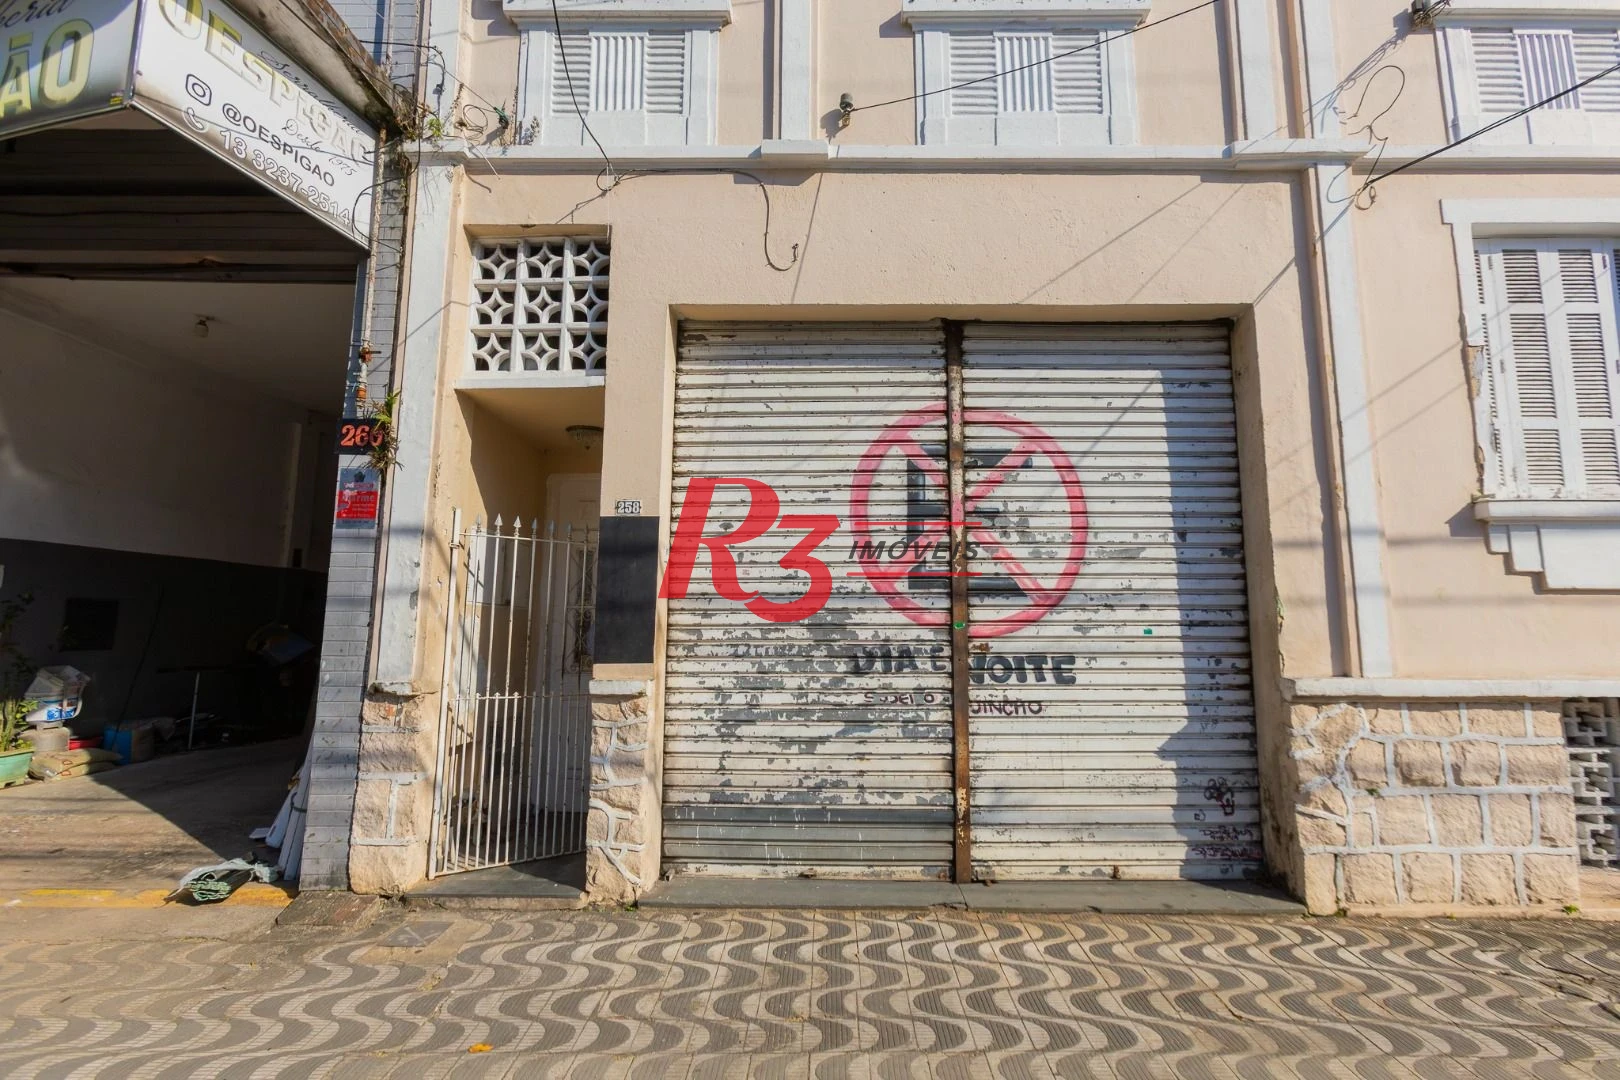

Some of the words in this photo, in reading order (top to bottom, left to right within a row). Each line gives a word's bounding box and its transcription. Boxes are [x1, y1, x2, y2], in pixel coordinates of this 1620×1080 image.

[220, 129, 248, 159] 13
[252, 150, 350, 225] 3237-2514
[222, 103, 335, 187] @OESPIGAO
[617, 501, 640, 513] 258
